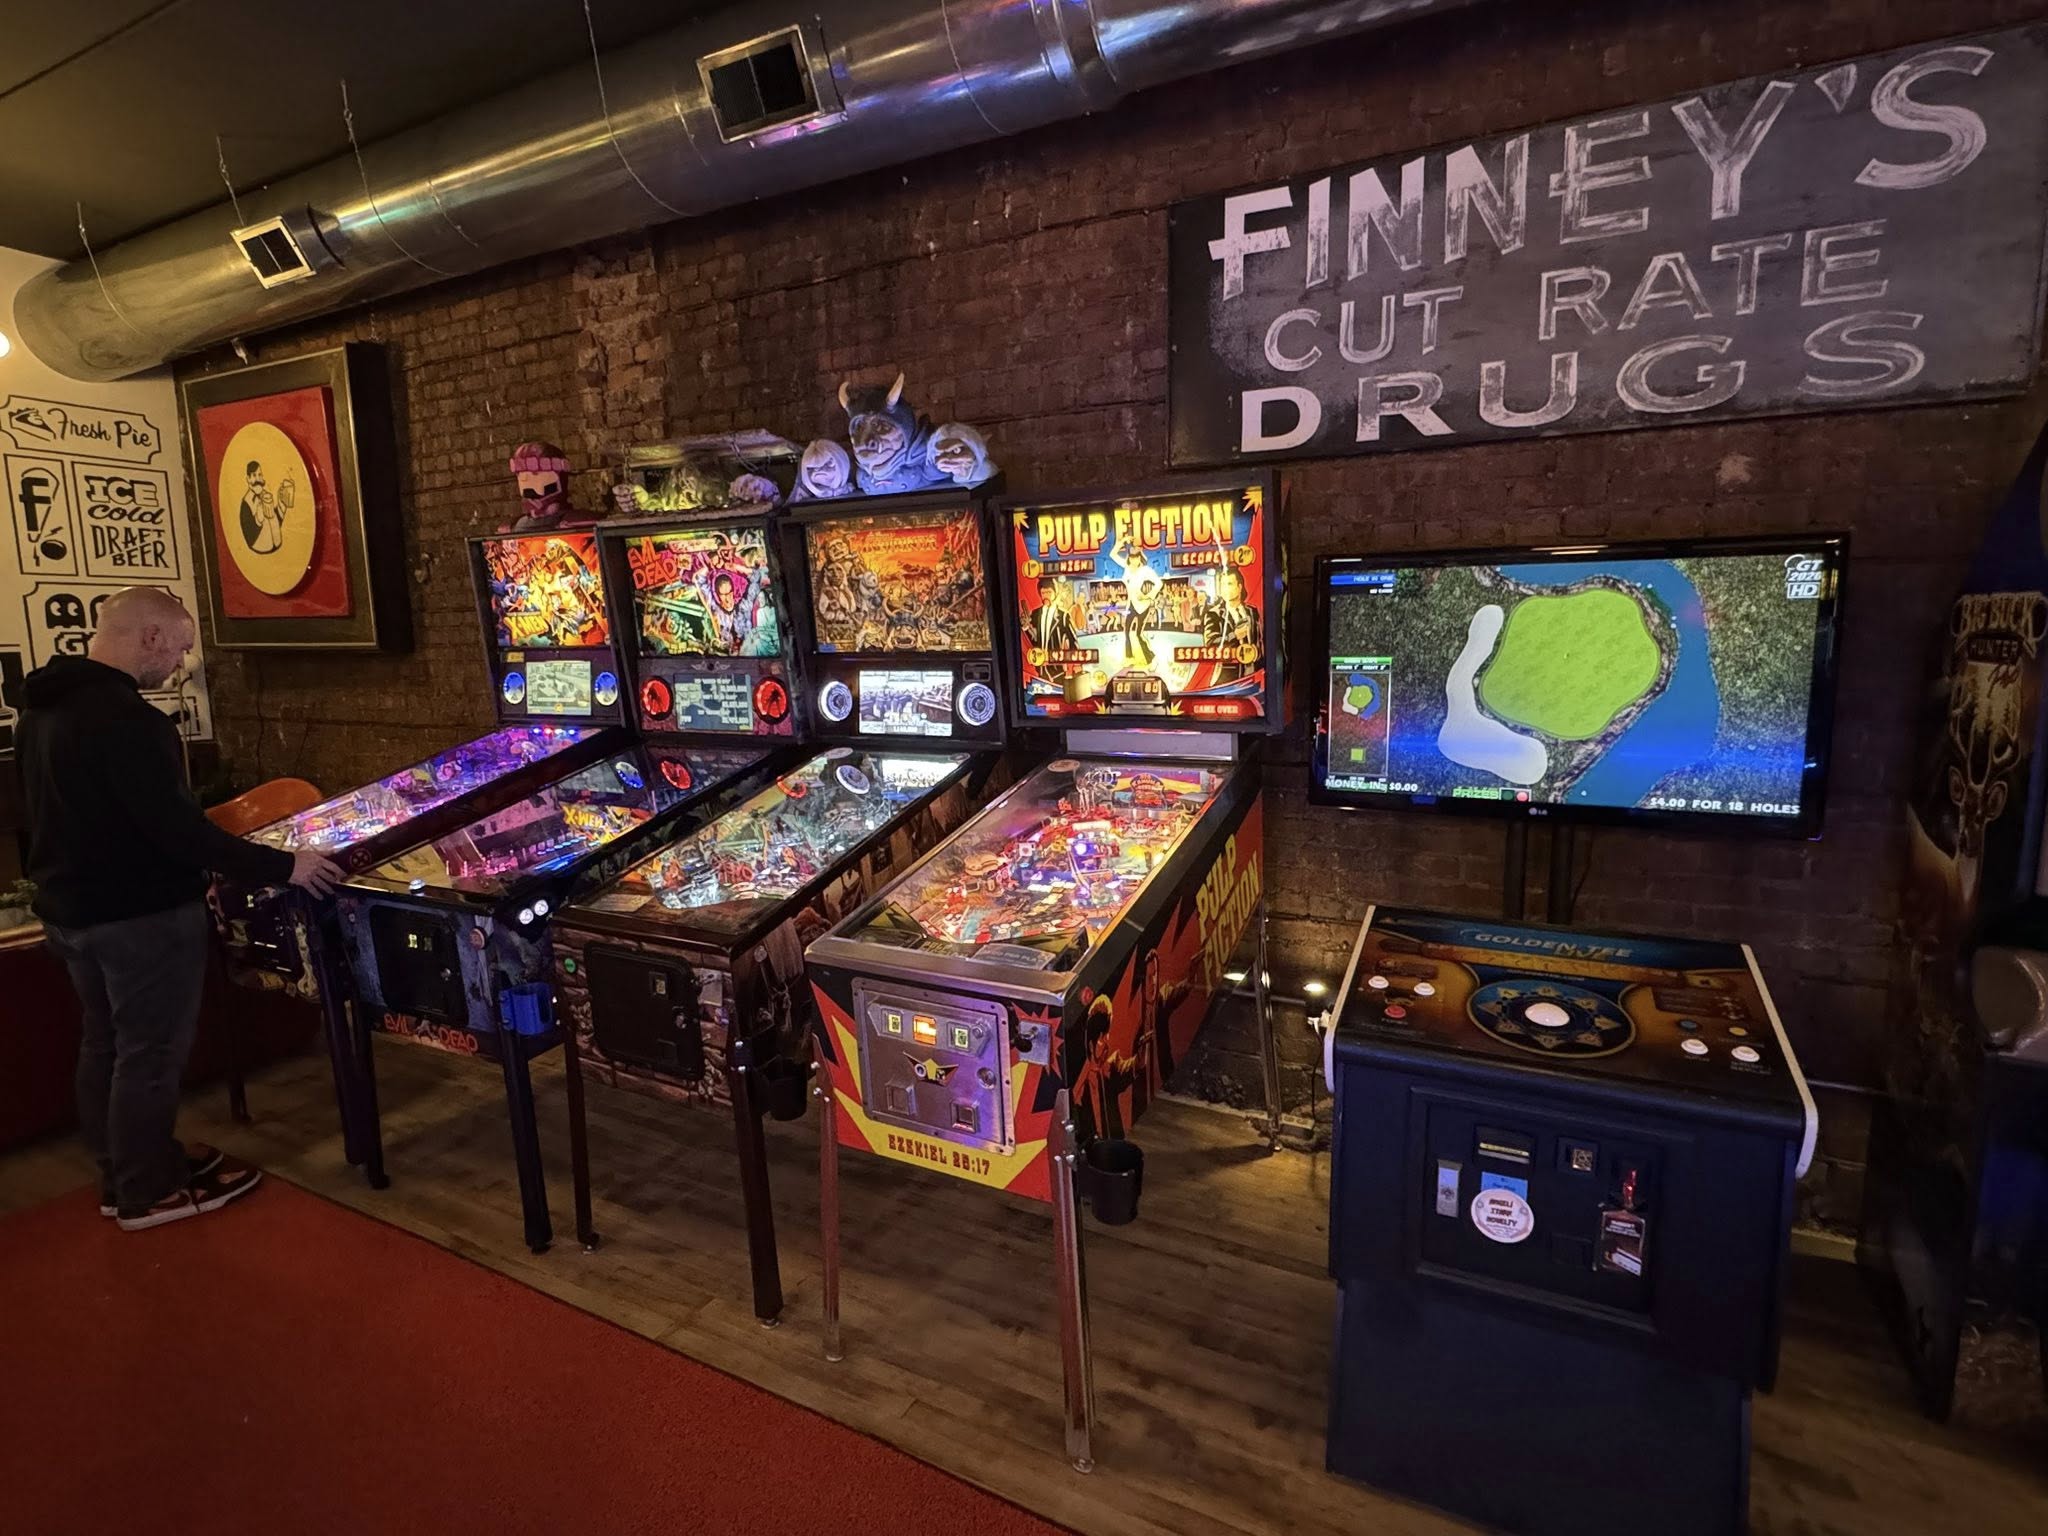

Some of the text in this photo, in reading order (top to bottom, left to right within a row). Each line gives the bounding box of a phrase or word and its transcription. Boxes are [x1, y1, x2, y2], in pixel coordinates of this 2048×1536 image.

[1208, 46, 1994, 302] FINNEY'S
[1264, 219, 1888, 372] CUT RATE
[1240, 311, 1926, 453] DRUGS
[48, 408, 152, 448] Fresh Pie
[85, 475, 159, 507] ICE
[88, 504, 165, 526] cold
[1037, 502, 1233, 557] PULP FICTION
[90, 524, 166, 559] DRAFT
[112, 540, 170, 569] BEER
[627, 537, 662, 570] EVIL
[633, 558, 679, 589] DEAD
[1790, 584, 1818, 596] HD
[1968, 640, 2019, 657] HUNTER
[1325, 778, 1364, 789] MONEY
[1389, 782, 1418, 792] $0.00
[1452, 788, 1499, 799] PRIZES
[1650, 797, 1801, 814] $4.00 FOR 18 HOLES
[1195, 833, 1237, 942] PULP
[1201, 852, 1261, 1001] FICTION
[384, 1012, 479, 1053] EVIL DEAD
[888, 1133, 947, 1165] EZEKIEL
